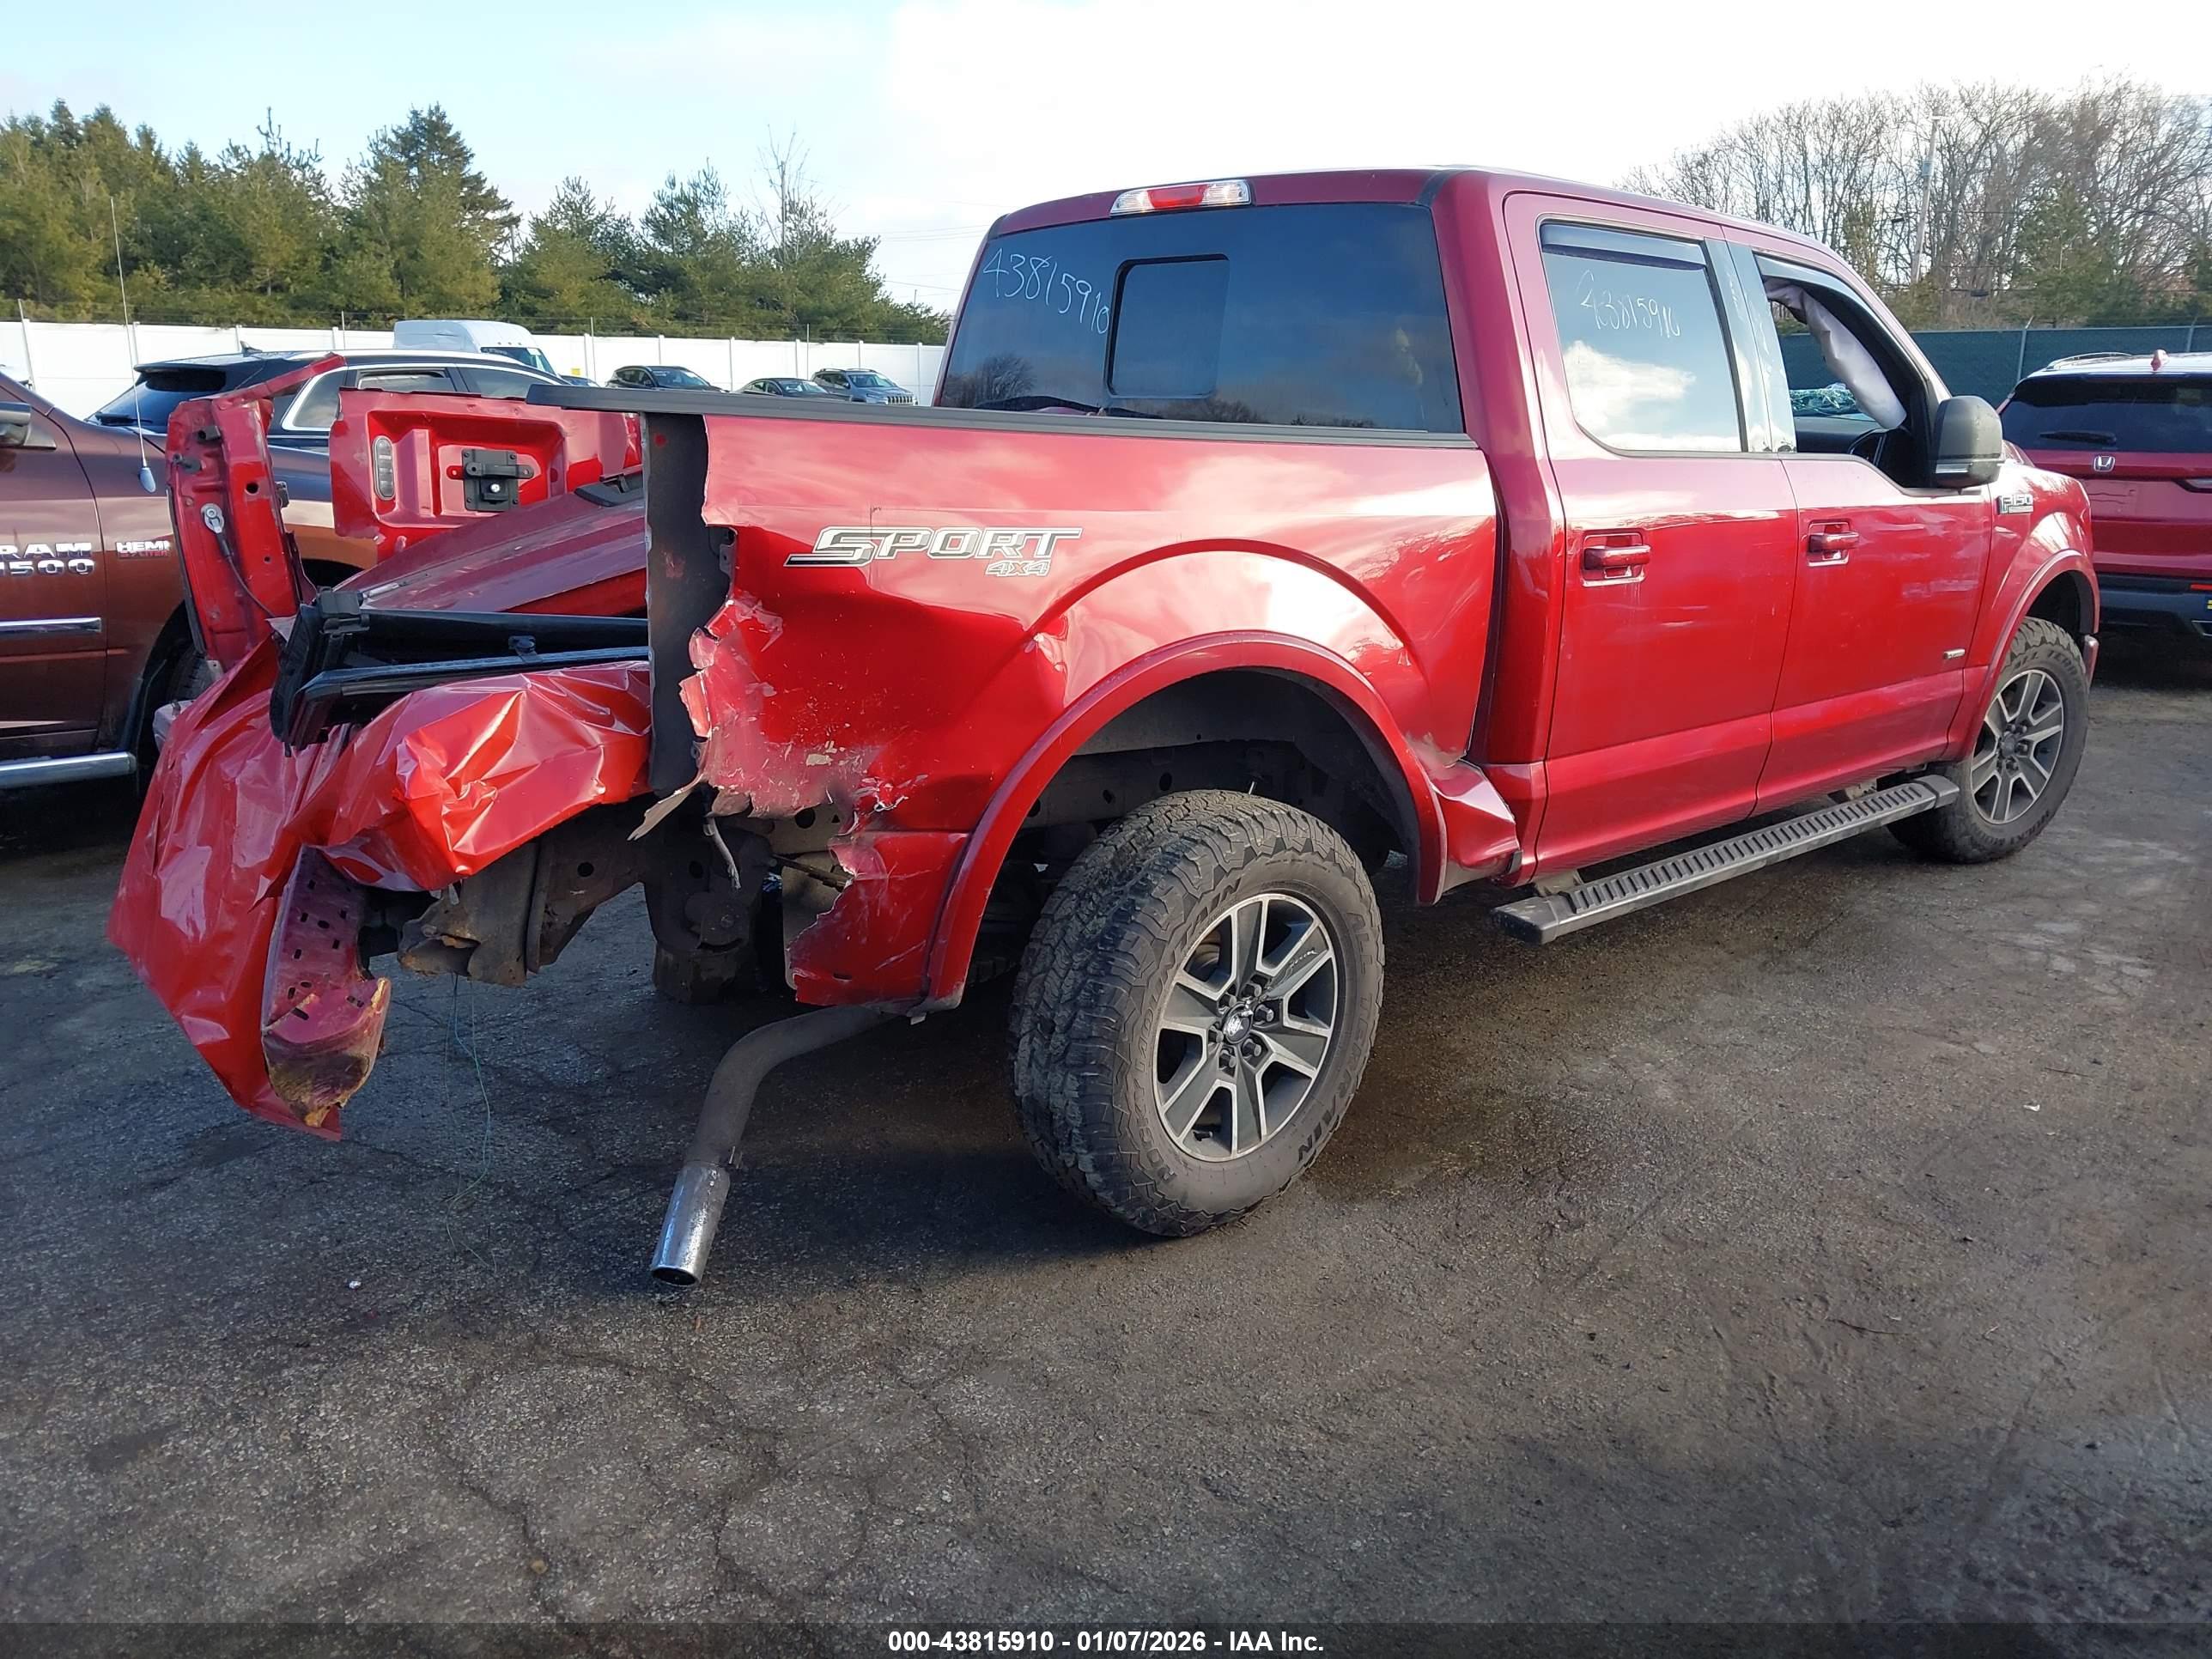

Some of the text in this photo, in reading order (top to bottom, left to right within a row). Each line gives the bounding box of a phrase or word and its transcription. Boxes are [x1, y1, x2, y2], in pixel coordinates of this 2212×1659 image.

[982, 247, 1110, 334] 43815910
[0, 541, 93, 560] RAM
[116, 539, 170, 551] HEMI
[783, 526, 1084, 567] SPORT
